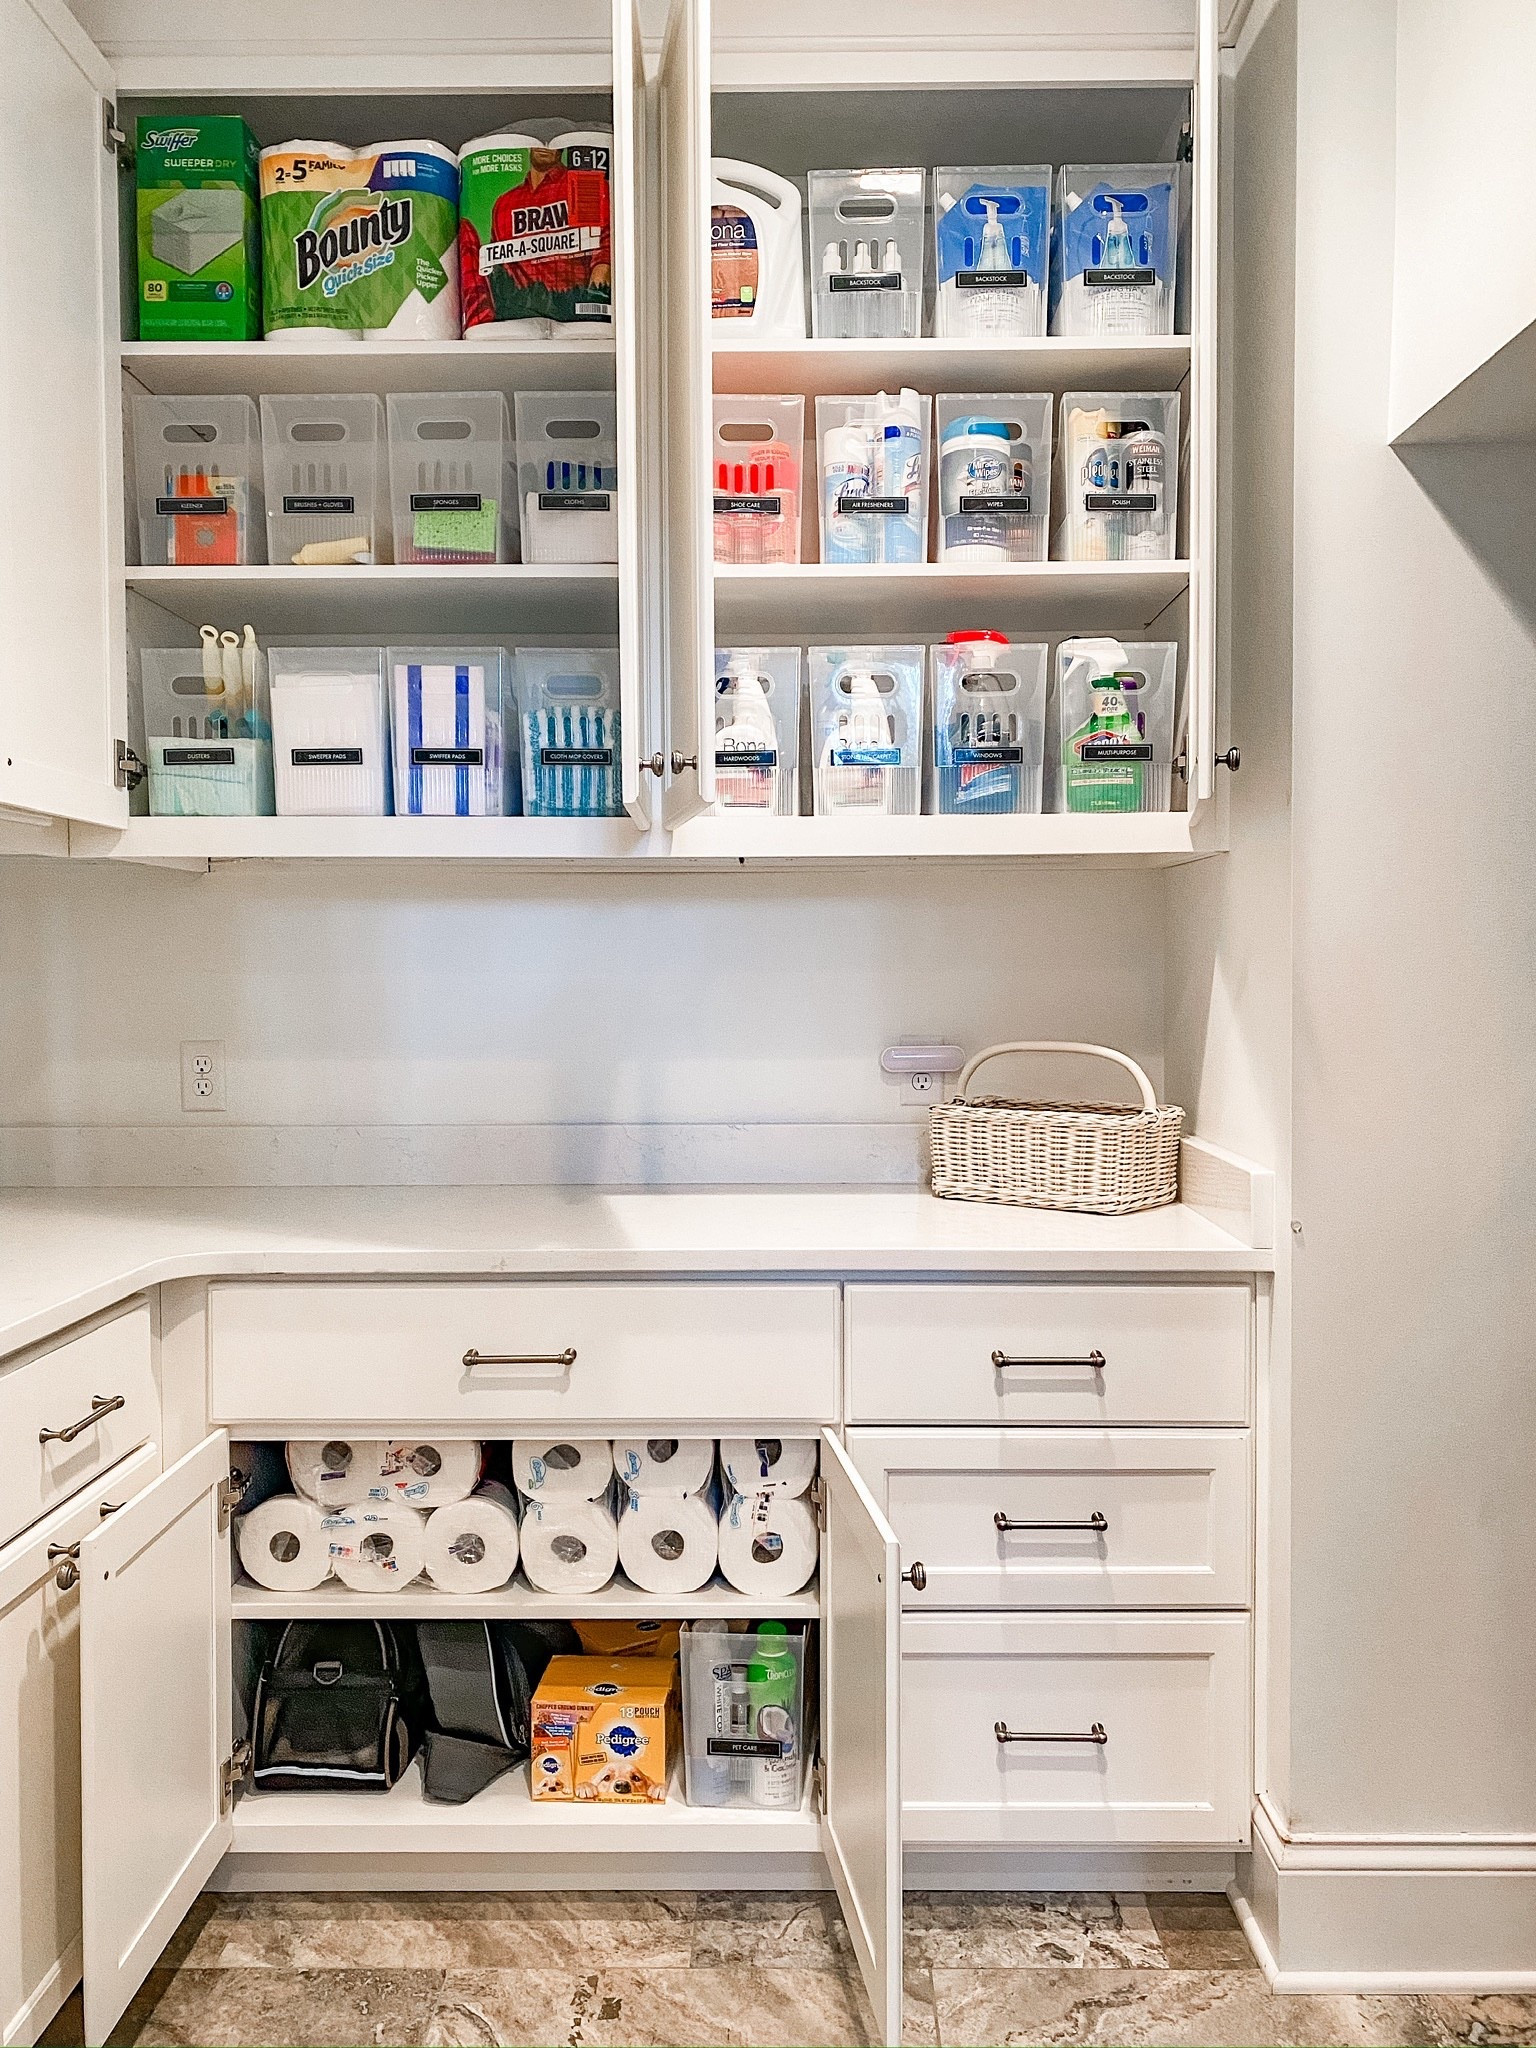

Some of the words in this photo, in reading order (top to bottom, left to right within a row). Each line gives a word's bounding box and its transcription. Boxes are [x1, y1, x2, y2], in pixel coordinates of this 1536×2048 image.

[141, 129, 198, 152] Swiffer
[164, 159, 214, 168] SWEEPER
[215, 160, 237, 168] DRY
[472, 156, 490, 167] MORE
[492, 154, 523, 163] CHOICES
[501, 163, 523, 172] TASKS
[296, 200, 411, 288] Bounty
[416, 258, 430, 266] The
[323, 263, 363, 297] Quick
[364, 251, 394, 276] Size
[416, 265, 443, 276] Quicker
[147, 283, 163, 292] 80
[850, 278, 882, 287] BACKSTOCK
[1132, 445, 1160, 454] WEIMAN
[973, 459, 999, 468] Miracle
[1128, 458, 1163, 467] STAINLESS
[976, 468, 998, 479] Wipes
[1137, 465, 1157, 473] STEEL
[584, 1683, 627, 1694] Pedigree
[620, 1707, 635, 1719] 18
[634, 1707, 660, 1715] POUCH
[596, 1733, 650, 1747] Pedigree
